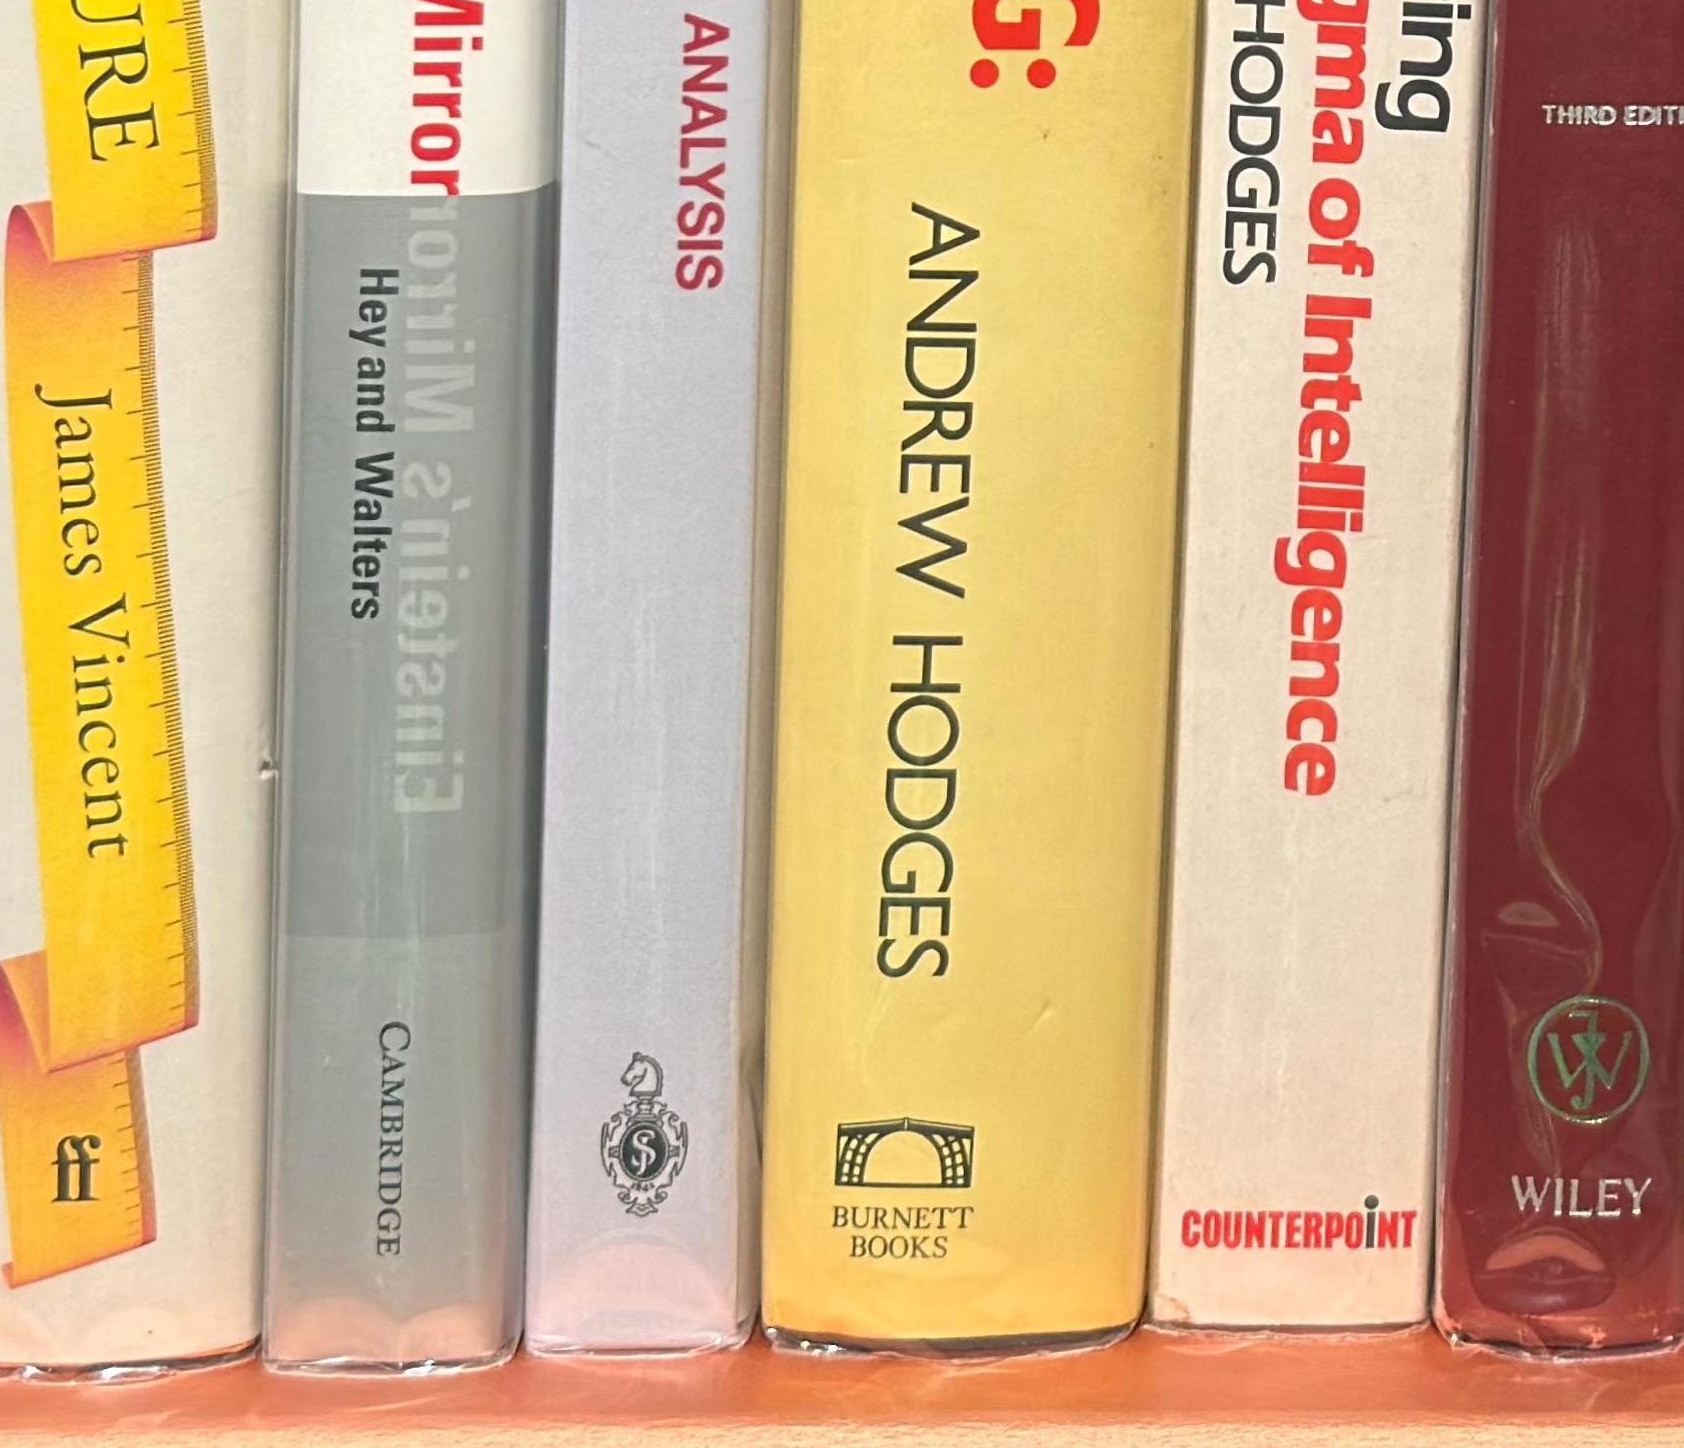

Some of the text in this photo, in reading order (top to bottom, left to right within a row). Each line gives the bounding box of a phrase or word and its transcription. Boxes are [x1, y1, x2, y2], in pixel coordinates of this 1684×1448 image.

[675, 13, 729, 290] ANALYSIS
[1308, 178, 1374, 277] of
[1542, 105, 1616, 125] THIRD
[349, 269, 399, 619] Hey and Walters
[1274, 294, 1372, 796] Intelligence
[35, 384, 130, 858] James Vincent
[877, 202, 980, 977] ANDREW HODGES
[377, 1022, 410, 1255] CAMBRIDGE
[832, 1206, 974, 1229] BURNETT
[850, 1235, 947, 1258] BOOKS
[1512, 1175, 1651, 1218] WILEY
